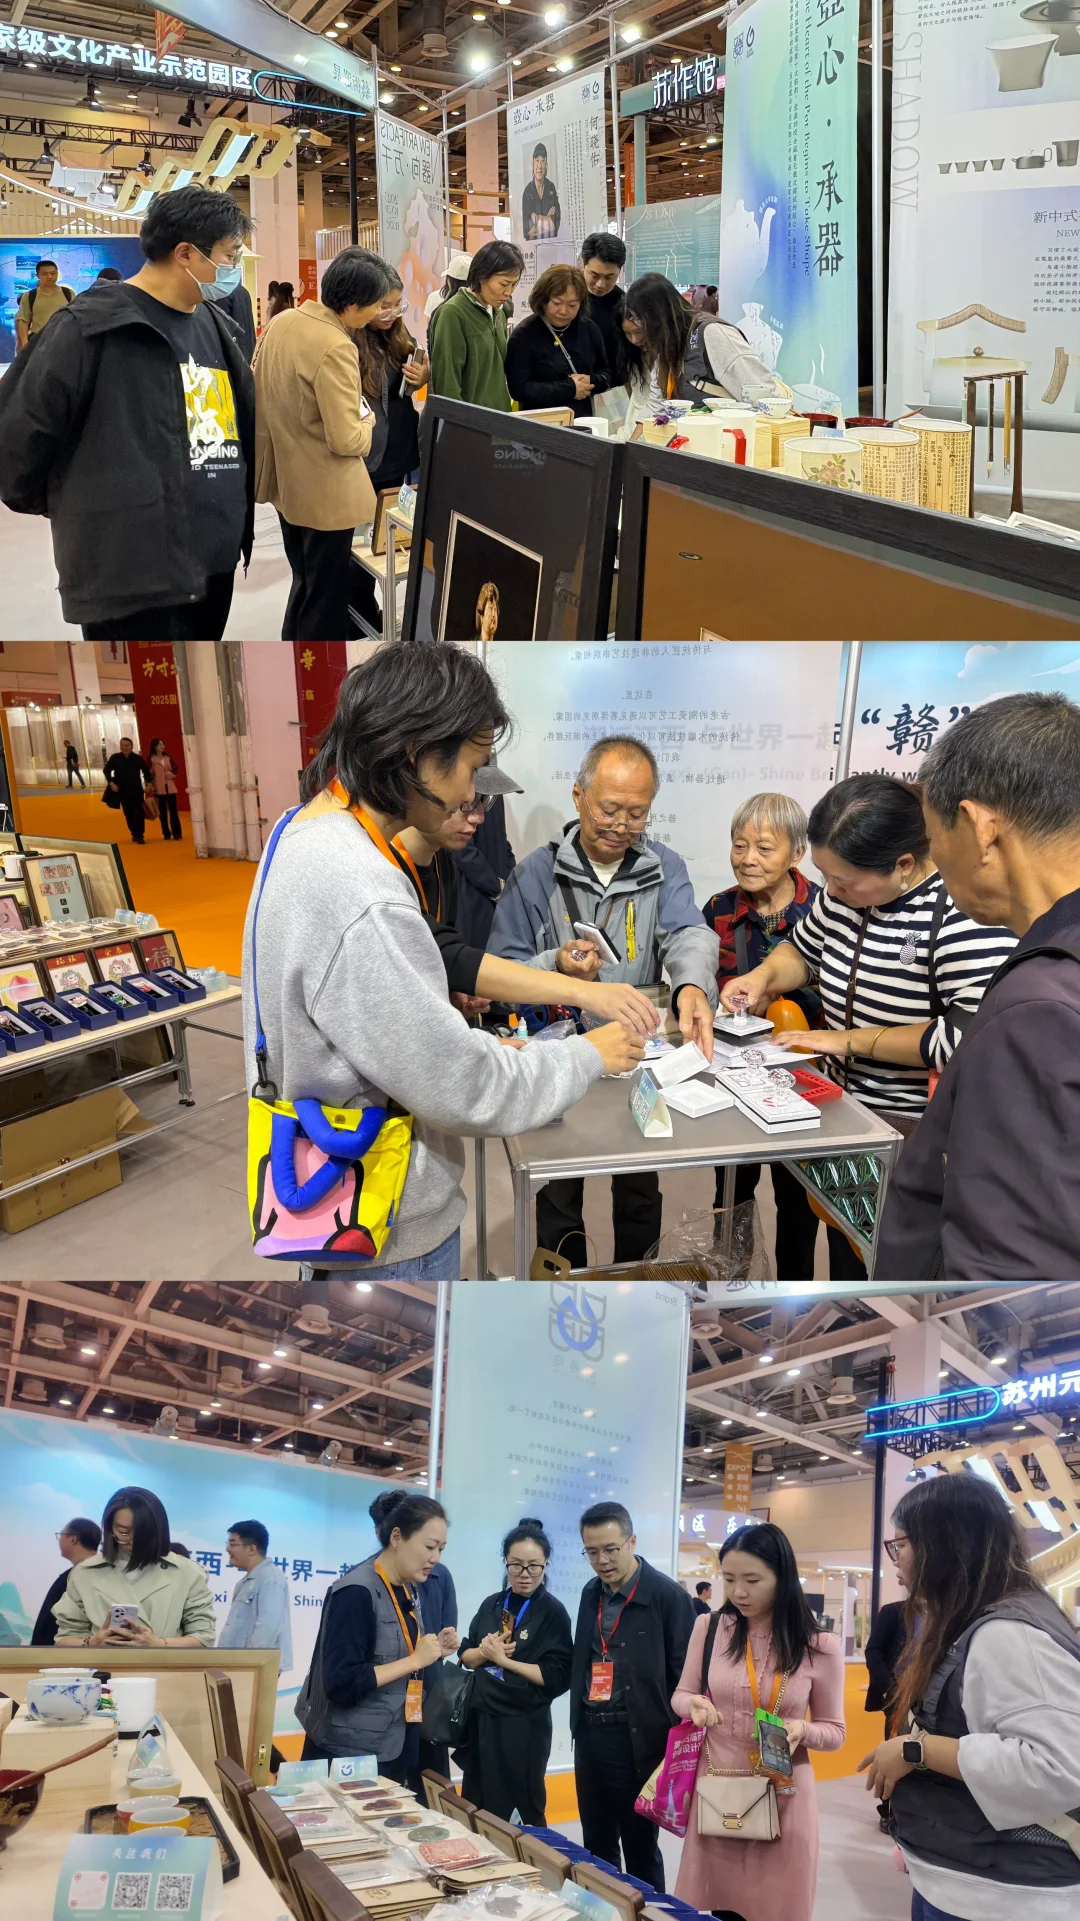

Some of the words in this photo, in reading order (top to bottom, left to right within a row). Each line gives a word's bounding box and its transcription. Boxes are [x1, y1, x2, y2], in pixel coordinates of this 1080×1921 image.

[651, 53, 717, 109] 苏作馆
[891, 32, 923, 212] SHADOW
[1033, 209, 1080, 224] 新中式
[294, 1595, 323, 1607] Shin
